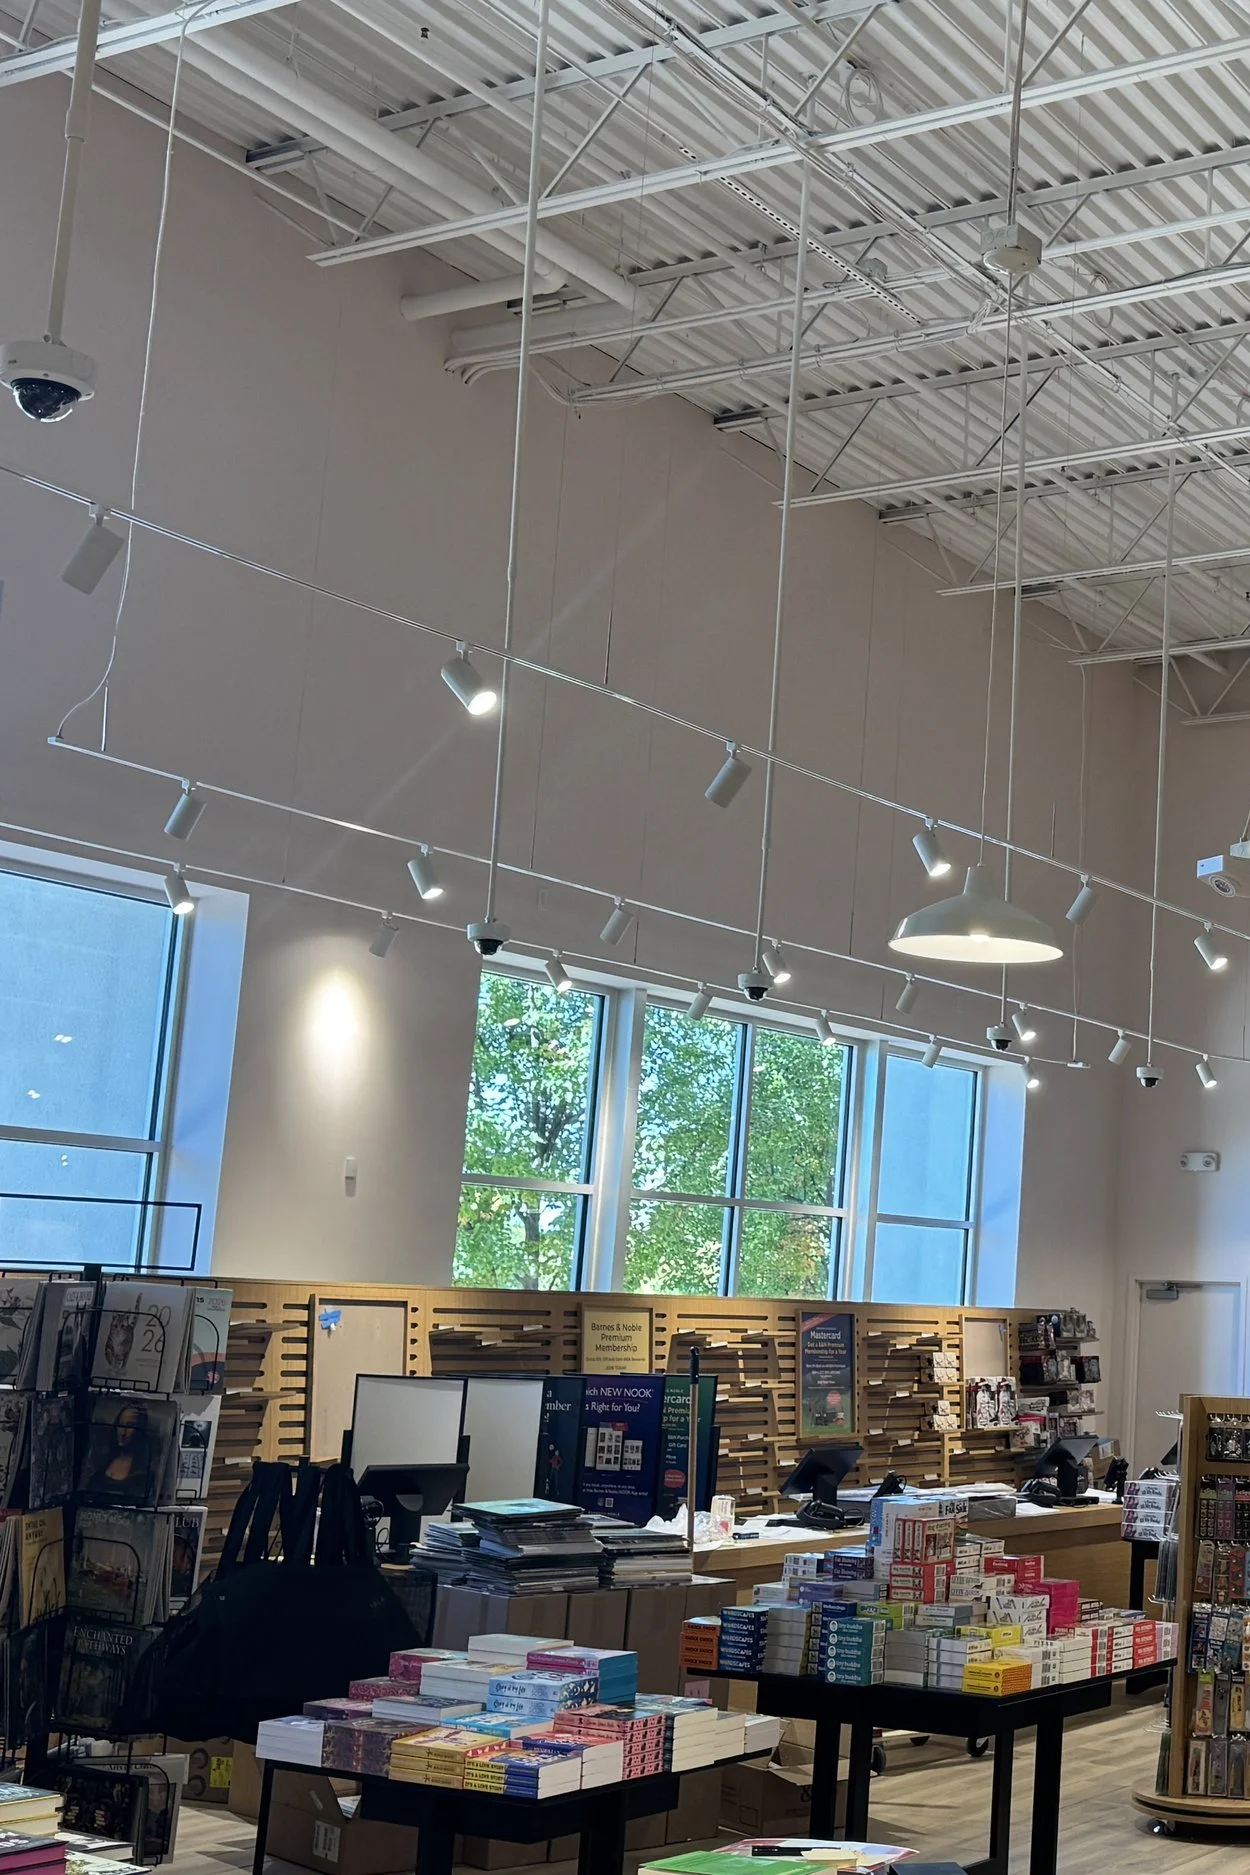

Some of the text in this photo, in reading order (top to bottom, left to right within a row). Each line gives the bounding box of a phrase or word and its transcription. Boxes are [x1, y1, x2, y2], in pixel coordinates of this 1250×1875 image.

[145, 1305, 172, 1328] 20
[591, 1323, 614, 1331] Barnes
[623, 1323, 642, 1331] Noble
[601, 1333, 633, 1341] Premium
[810, 1330, 841, 1339] Mastercard
[141, 1329, 165, 1353] 26
[596, 1344, 637, 1352] Membership
[600, 1387, 622, 1398] NEW
[624, 1388, 652, 1398] NOOK
[591, 1401, 609, 1413] Right
[611, 1401, 622, 1411] for
[624, 1402, 641, 1412] You?
[73, 1625, 133, 1646] ENCHANTED
[76, 1637, 126, 1656] PATHWAYS
